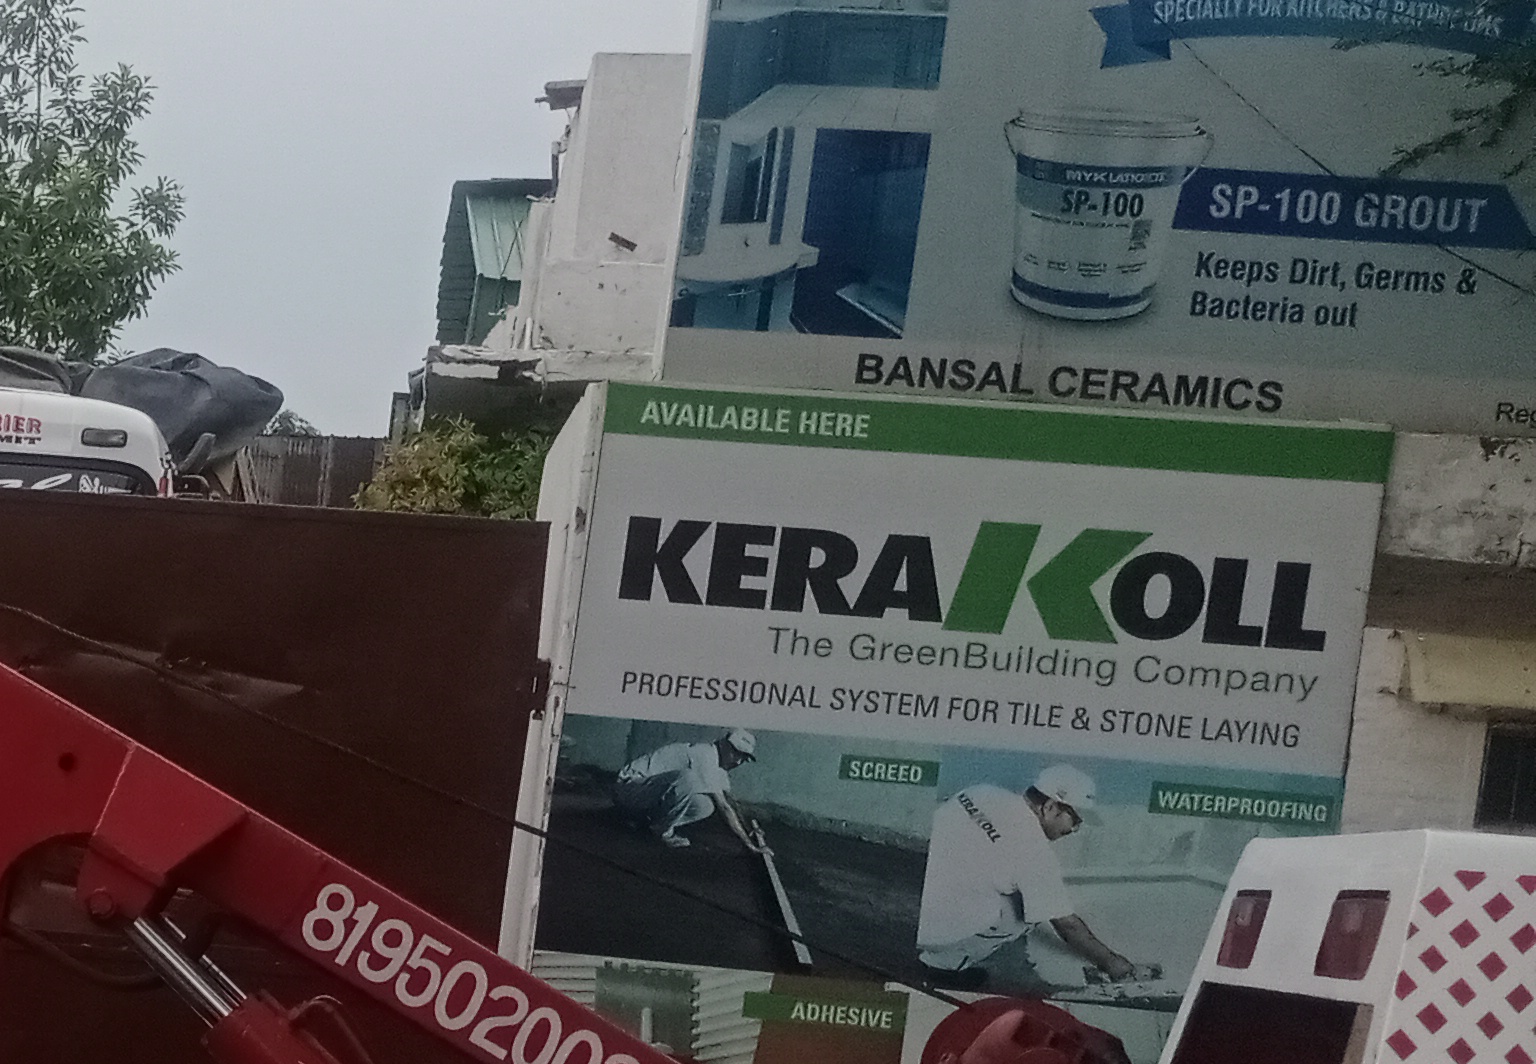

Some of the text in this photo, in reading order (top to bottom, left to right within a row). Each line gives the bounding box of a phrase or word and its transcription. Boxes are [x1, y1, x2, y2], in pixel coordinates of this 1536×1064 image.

[1059, 189, 1145, 218] SP-100
[1209, 183, 1489, 233] SP-100 GROUT
[1194, 250, 1478, 294] Keeps Dirt, Germs &
[1189, 291, 1358, 327] Bacteria out
[854, 352, 1284, 414] BANSAL CERAMICS
[639, 401, 870, 438] AVAILABLE HERE
[768, 626, 1320, 703] The GreenBuilding Company
[620, 672, 1301, 748] PROFESSIONAL SYSTEM FOR TILE & STONE LAYING
[848, 760, 922, 784] SCREED
[1157, 790, 1328, 823] WATERPROOFING
[790, 1001, 893, 1029] ADHESIVE
